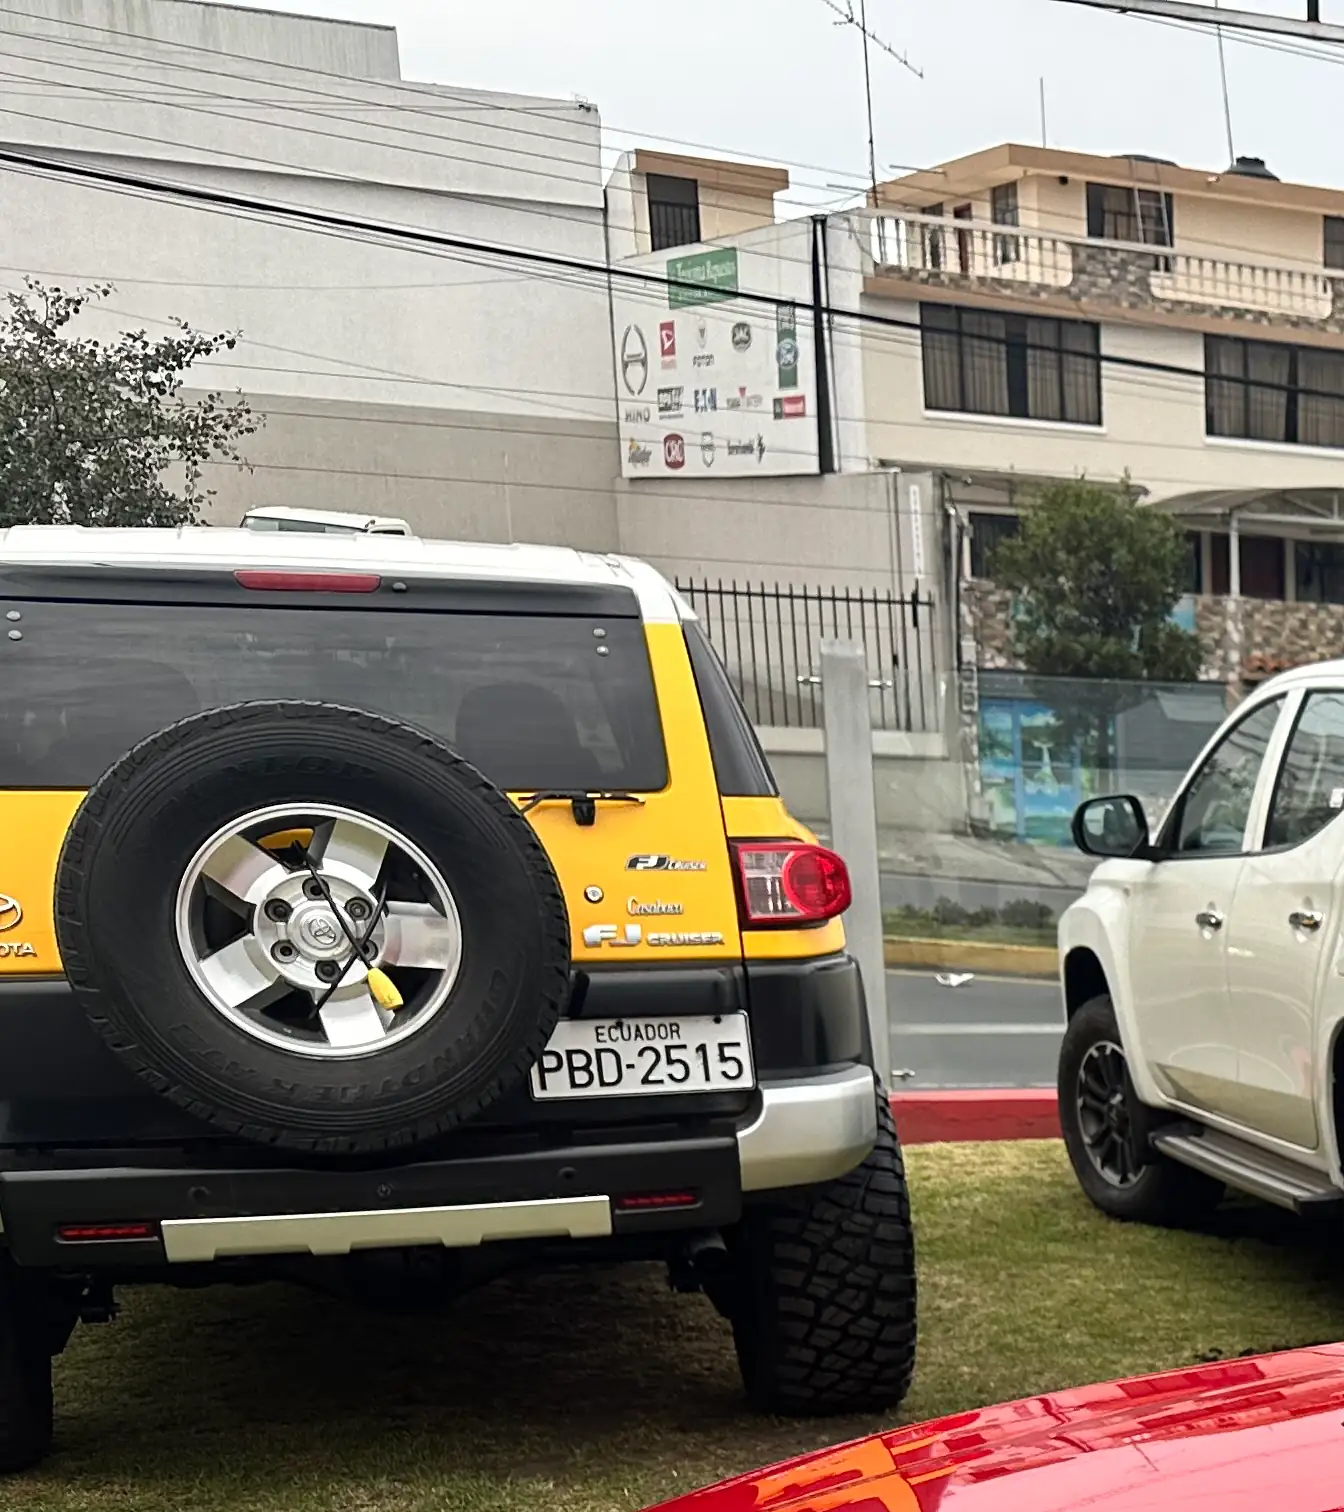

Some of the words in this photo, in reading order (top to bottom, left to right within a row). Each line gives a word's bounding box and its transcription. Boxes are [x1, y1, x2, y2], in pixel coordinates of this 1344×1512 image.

[624, 407, 651, 422] HINO
[583, 923, 642, 948] FJ
[646, 931, 725, 947] CRUISER
[595, 1022, 681, 1043] ECUADOR
[537, 1041, 744, 1091] PBD-2515
